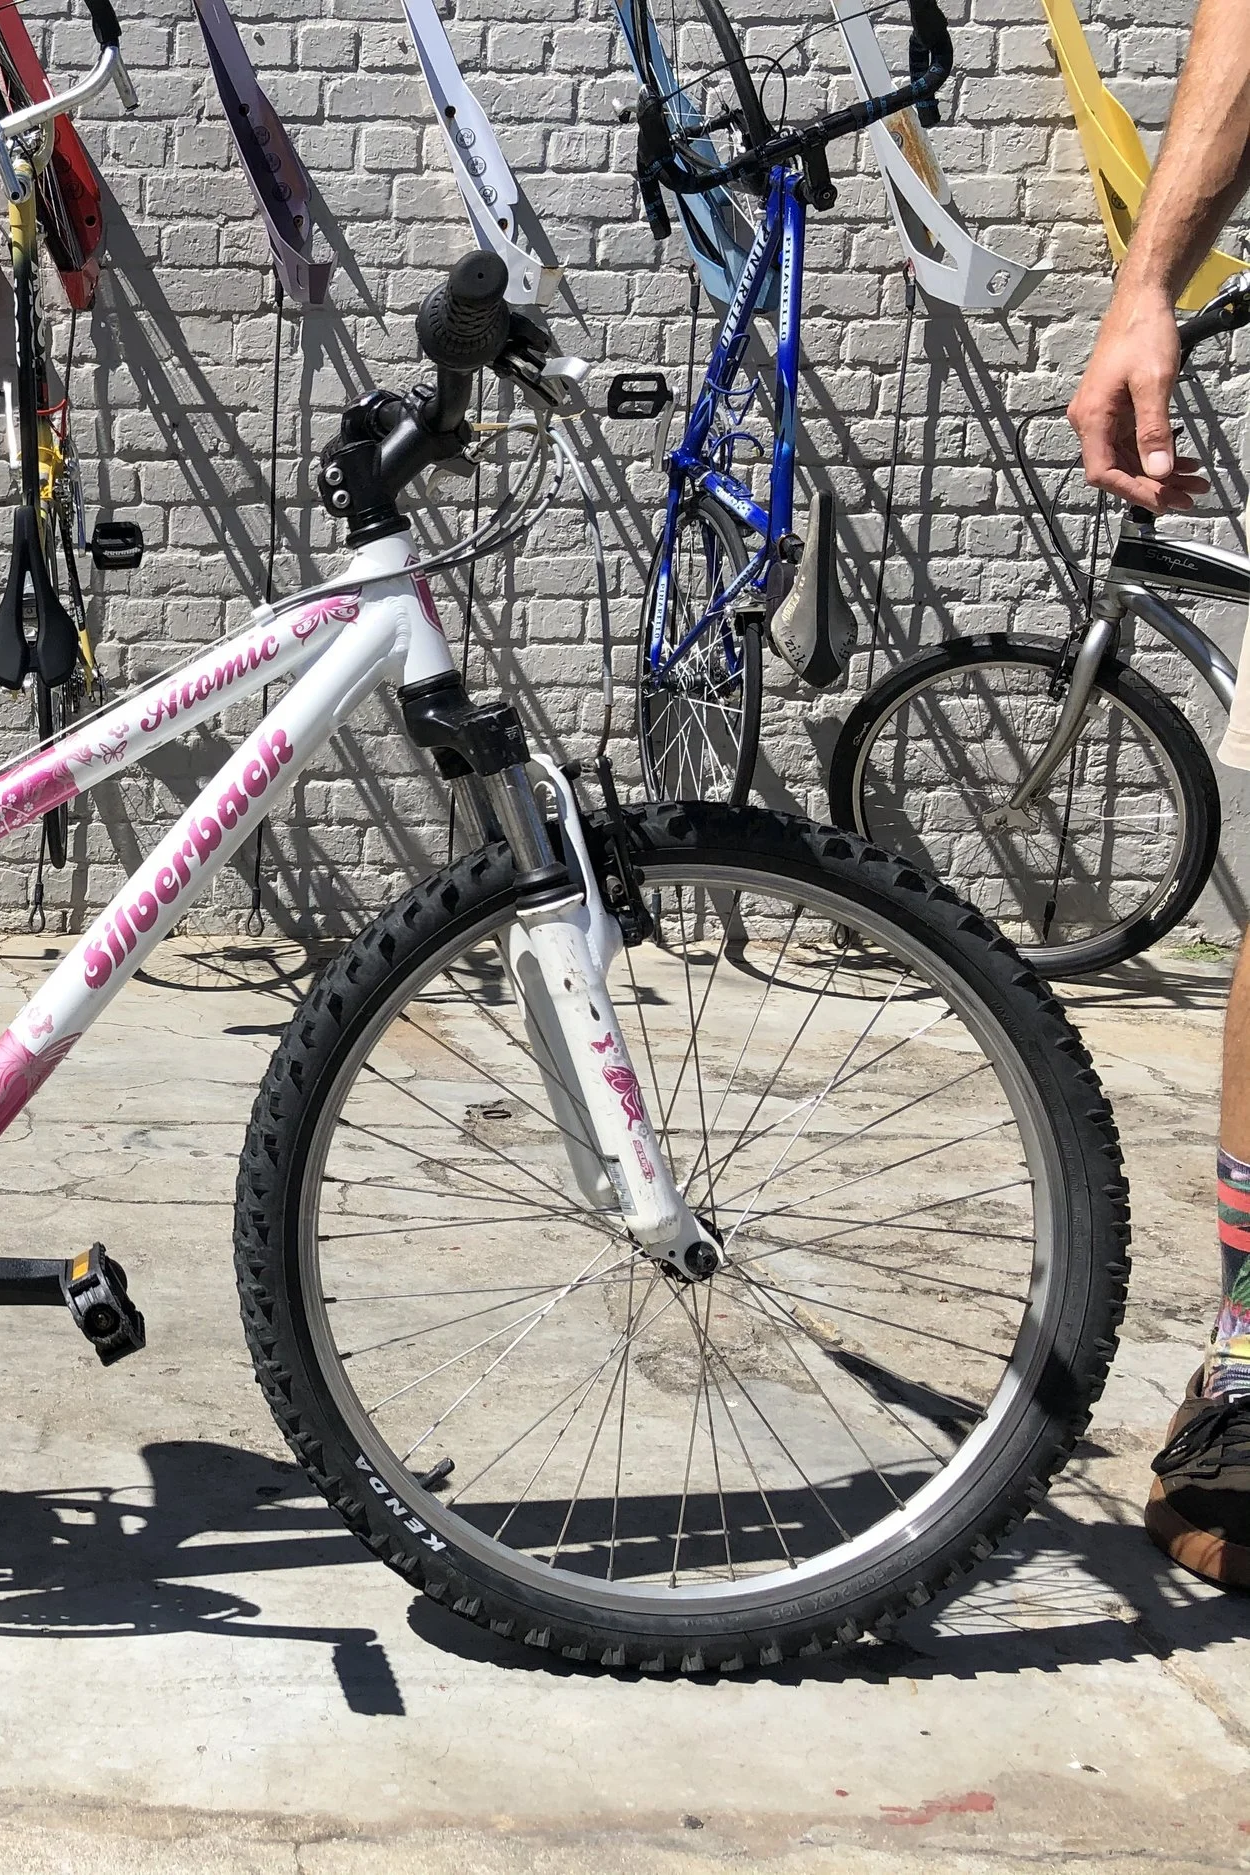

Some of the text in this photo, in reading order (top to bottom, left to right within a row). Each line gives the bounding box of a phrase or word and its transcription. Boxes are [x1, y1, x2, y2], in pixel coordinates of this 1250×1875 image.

[720, 224, 770, 350] PINARELLO
[777, 236, 792, 342] PINARELLO
[1144, 548, 1199, 571] Simple
[140, 634, 280, 733] Atomic
[83, 728, 294, 990] Silverback
[354, 1451, 447, 1552] KENDA
